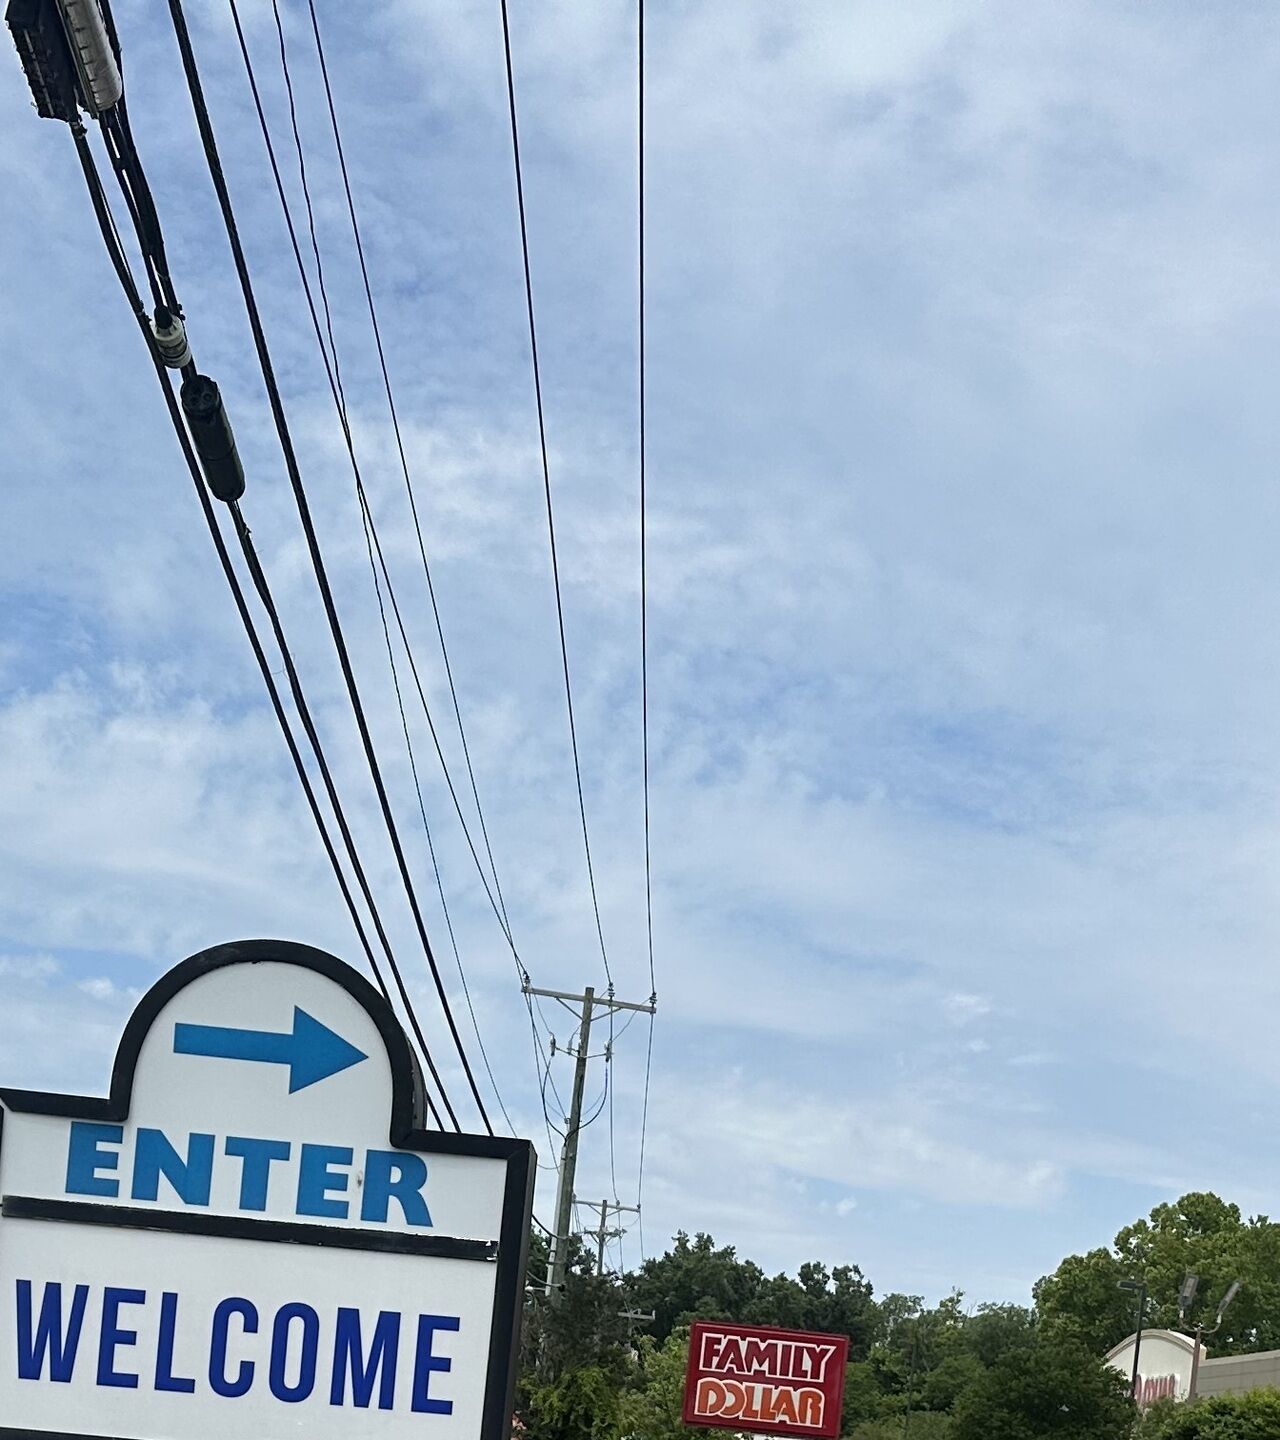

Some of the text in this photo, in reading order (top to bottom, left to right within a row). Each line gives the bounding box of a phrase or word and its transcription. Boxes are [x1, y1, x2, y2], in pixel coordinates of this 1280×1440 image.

[65, 1121, 433, 1228] ENTER
[16, 1279, 461, 1415] WELCOME
[699, 1332, 837, 1383] FAMILY
[694, 1377, 825, 1428] DOLLAR
